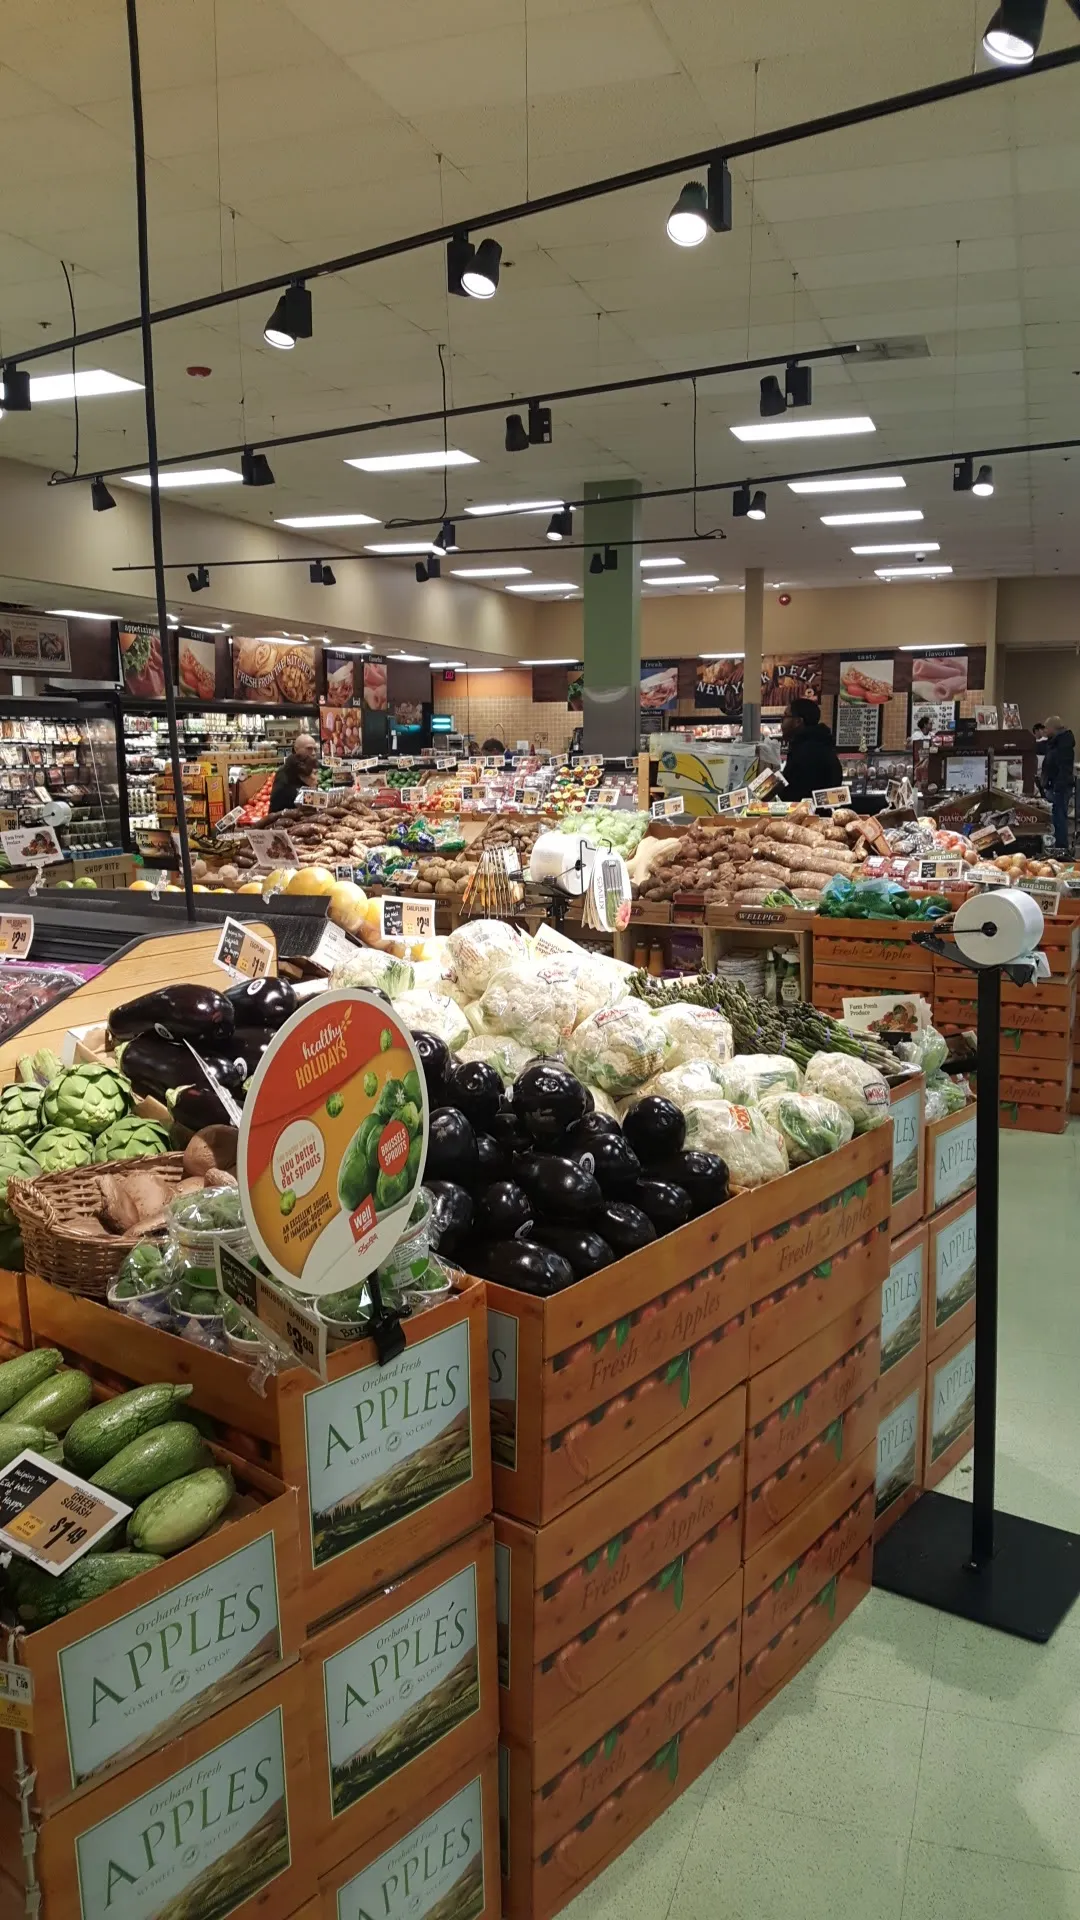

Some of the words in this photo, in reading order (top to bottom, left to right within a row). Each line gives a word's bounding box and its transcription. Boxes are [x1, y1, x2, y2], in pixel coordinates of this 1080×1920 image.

[237, 671, 258, 688] FRESH
[258, 674, 275, 689] FROM
[274, 659, 286, 676] THE
[286, 655, 316, 680] KITCHEN
[697, 682, 727, 696] NEW
[778, 665, 816, 683] DELI
[1021, 882, 1052, 890] organic
[832, 946, 858, 956] Fresh
[877, 948, 912, 960] Apples
[1008, 1011, 1044, 1026] Apples
[302, 1023, 343, 1060] healthy
[295, 1040, 348, 1090] HOLIDAYS
[280, 1158, 295, 1178] you
[295, 1141, 317, 1164] better
[380, 1128, 406, 1157] BRUSSELS
[384, 1141, 407, 1166] SPROUTS
[281, 1173, 294, 1189] eat
[295, 1153, 322, 1180] sprouts
[283, 1224, 289, 1235] AN
[290, 1205, 312, 1229] EXCELLENT
[313, 1191, 329, 1211] SOURCE
[299, 1221, 318, 1242] VITAMIN
[353, 1205, 371, 1229] well
[283, 1233, 290, 1244] OF
[777, 1236, 813, 1272] Fresh
[836, 1202, 873, 1239] Apples
[288, 1308, 318, 1337] SPROUTS
[589, 1343, 639, 1391] Fresh
[671, 1292, 721, 1341] Apples
[362, 1364, 398, 1393] Orchard
[400, 1358, 422, 1374] Fresh
[323, 1364, 460, 1472] APPLES
[360, 1446, 382, 1463] SWEET
[415, 1418, 433, 1433] CRISP
[14, 1469, 36, 1482] Helping
[37, 1475, 48, 1485] You
[14, 1483, 34, 1494] Well
[2, 1496, 25, 1513] Happy
[60, 1498, 92, 1519] SQUASH
[70, 1492, 97, 1509] GREEN
[581, 1561, 631, 1613] Fresh
[663, 1493, 716, 1551] Apples
[825, 1531, 859, 1576] Apples
[135, 1604, 180, 1636] Orchard
[183, 1586, 213, 1608] Fresh
[376, 1623, 408, 1650] Orchard
[410, 1608, 432, 1628] Fresh
[88, 1583, 264, 1728] APPLES
[341, 1605, 469, 1728] APPLES
[136, 1690, 166, 1712] SWEET
[207, 1649, 231, 1667] CRISP
[664, 1672, 712, 1726] Apples
[150, 1784, 192, 1816] Orchard
[196, 1762, 222, 1784] Fresh
[104, 1756, 271, 1911] APPLES
[387, 1844, 419, 1871] Orchard
[419, 1823, 440, 1845] Fresh
